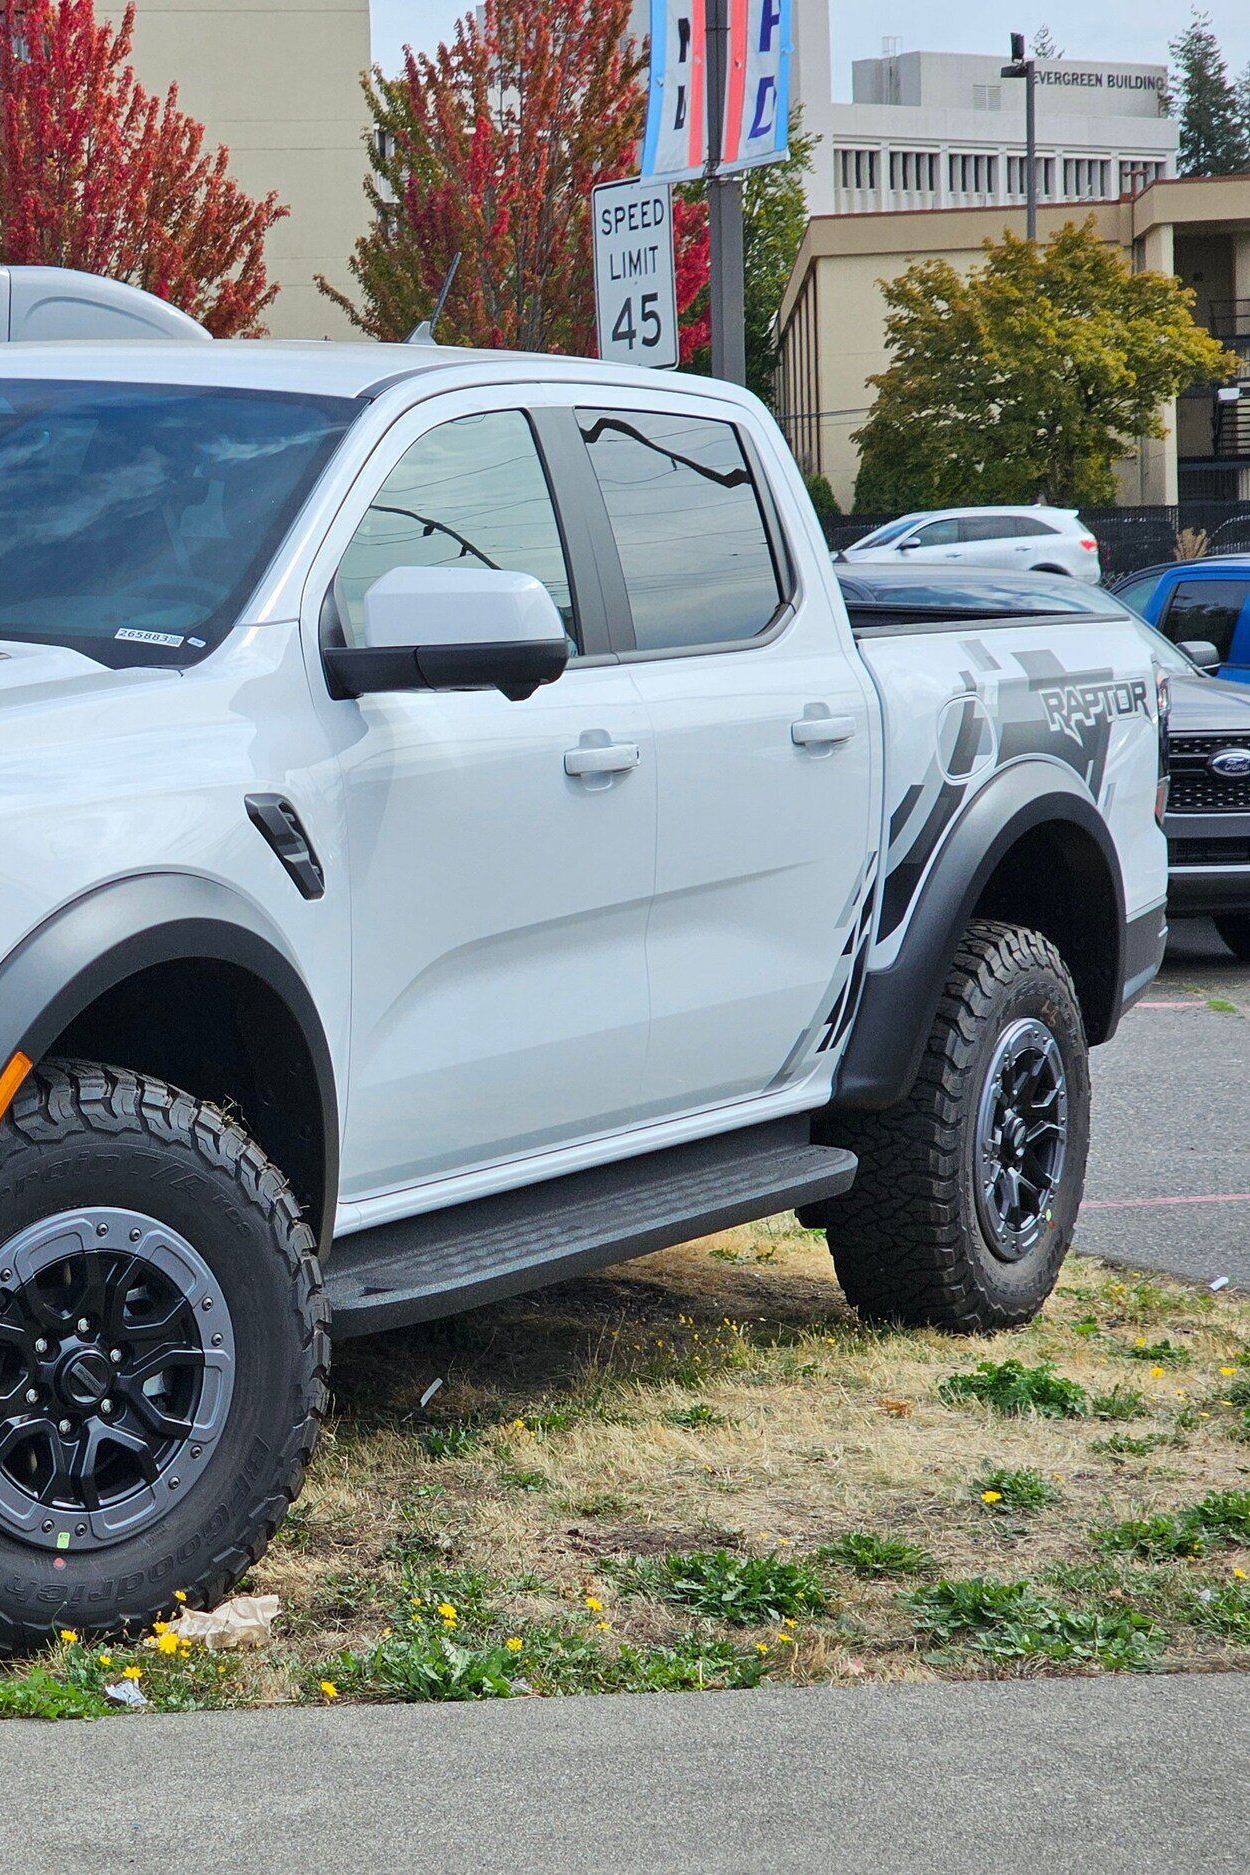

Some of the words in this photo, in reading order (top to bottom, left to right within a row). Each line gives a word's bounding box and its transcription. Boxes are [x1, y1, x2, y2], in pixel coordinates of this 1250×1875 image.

[1033, 71, 1103, 88] EVERGREEN
[1107, 74, 1165, 91] BUILDING
[601, 198, 665, 236] SPEED
[610, 245, 658, 281] LIMIT
[612, 291, 662, 350] 45
[118, 629, 169, 642] 265883
[1039, 678, 1155, 749] RAPTOR
[1224, 757, 1250, 771] Ford
